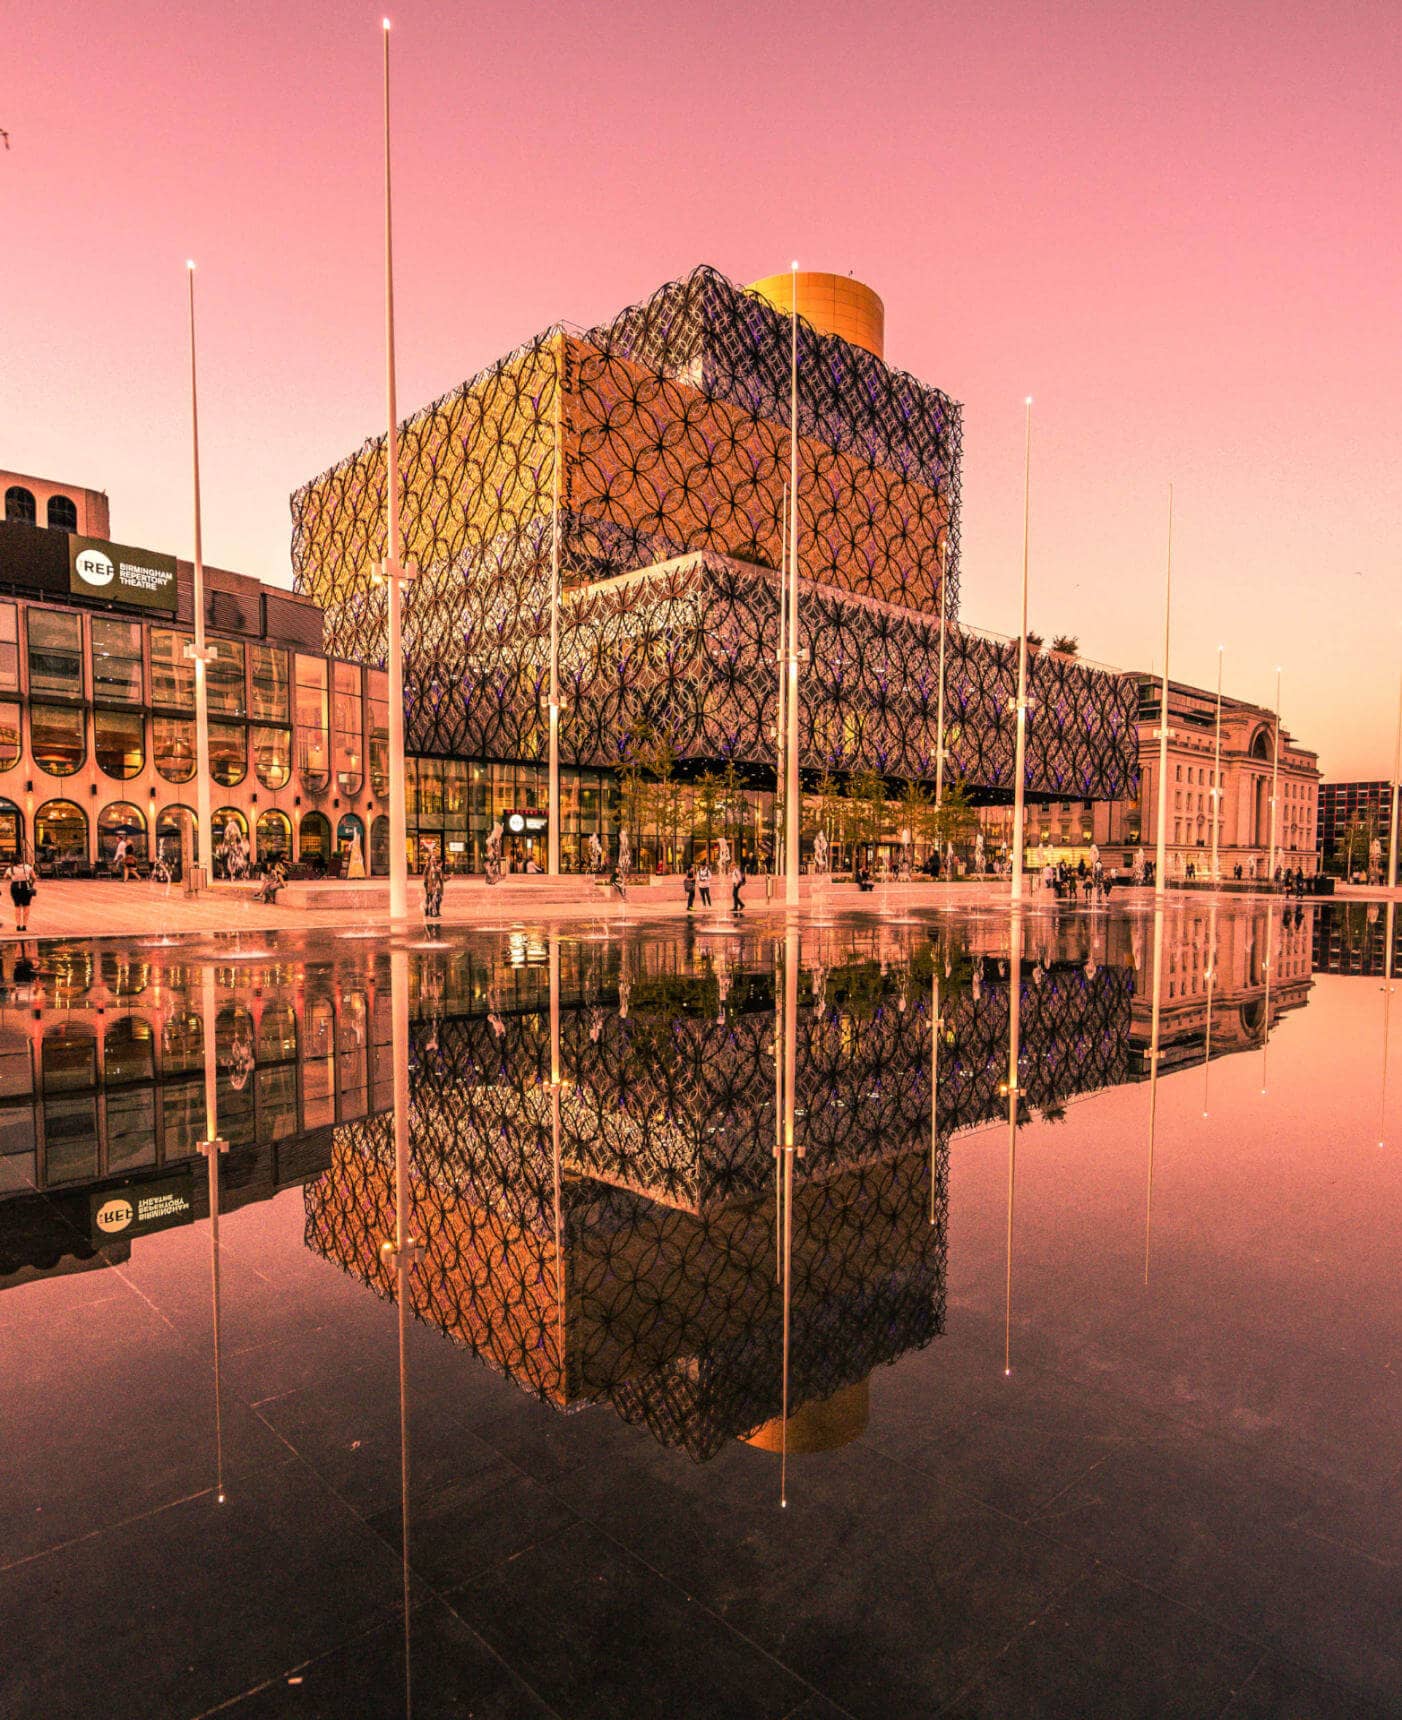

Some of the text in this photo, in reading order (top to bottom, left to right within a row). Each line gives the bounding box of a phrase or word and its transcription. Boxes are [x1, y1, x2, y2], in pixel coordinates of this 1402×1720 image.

[119, 562, 173, 580] BIRMINGHAM
[119, 570, 169, 586] REPERTORY
[119, 577, 157, 591] THEATRE
